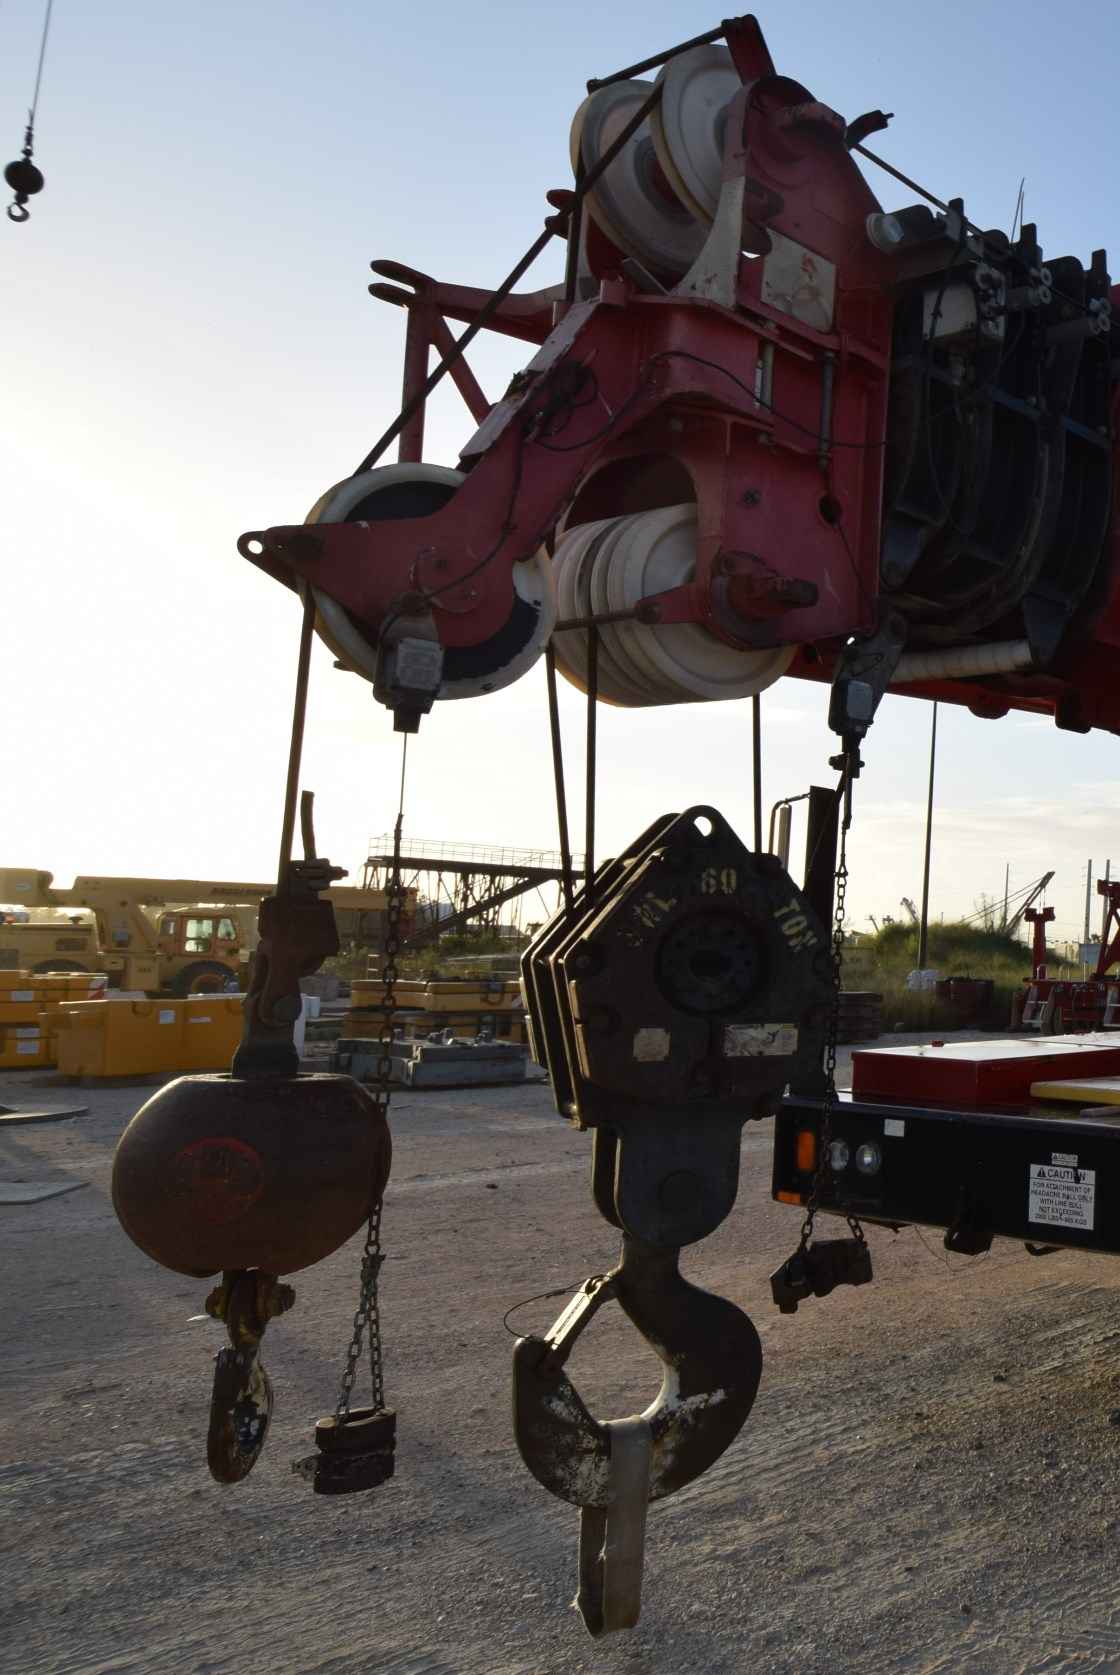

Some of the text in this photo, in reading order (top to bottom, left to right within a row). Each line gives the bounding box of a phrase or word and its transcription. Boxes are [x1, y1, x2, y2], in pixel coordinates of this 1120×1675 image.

[701, 867, 818, 953] 60 TON
[1047, 1168, 1086, 1182] CAUTIN
